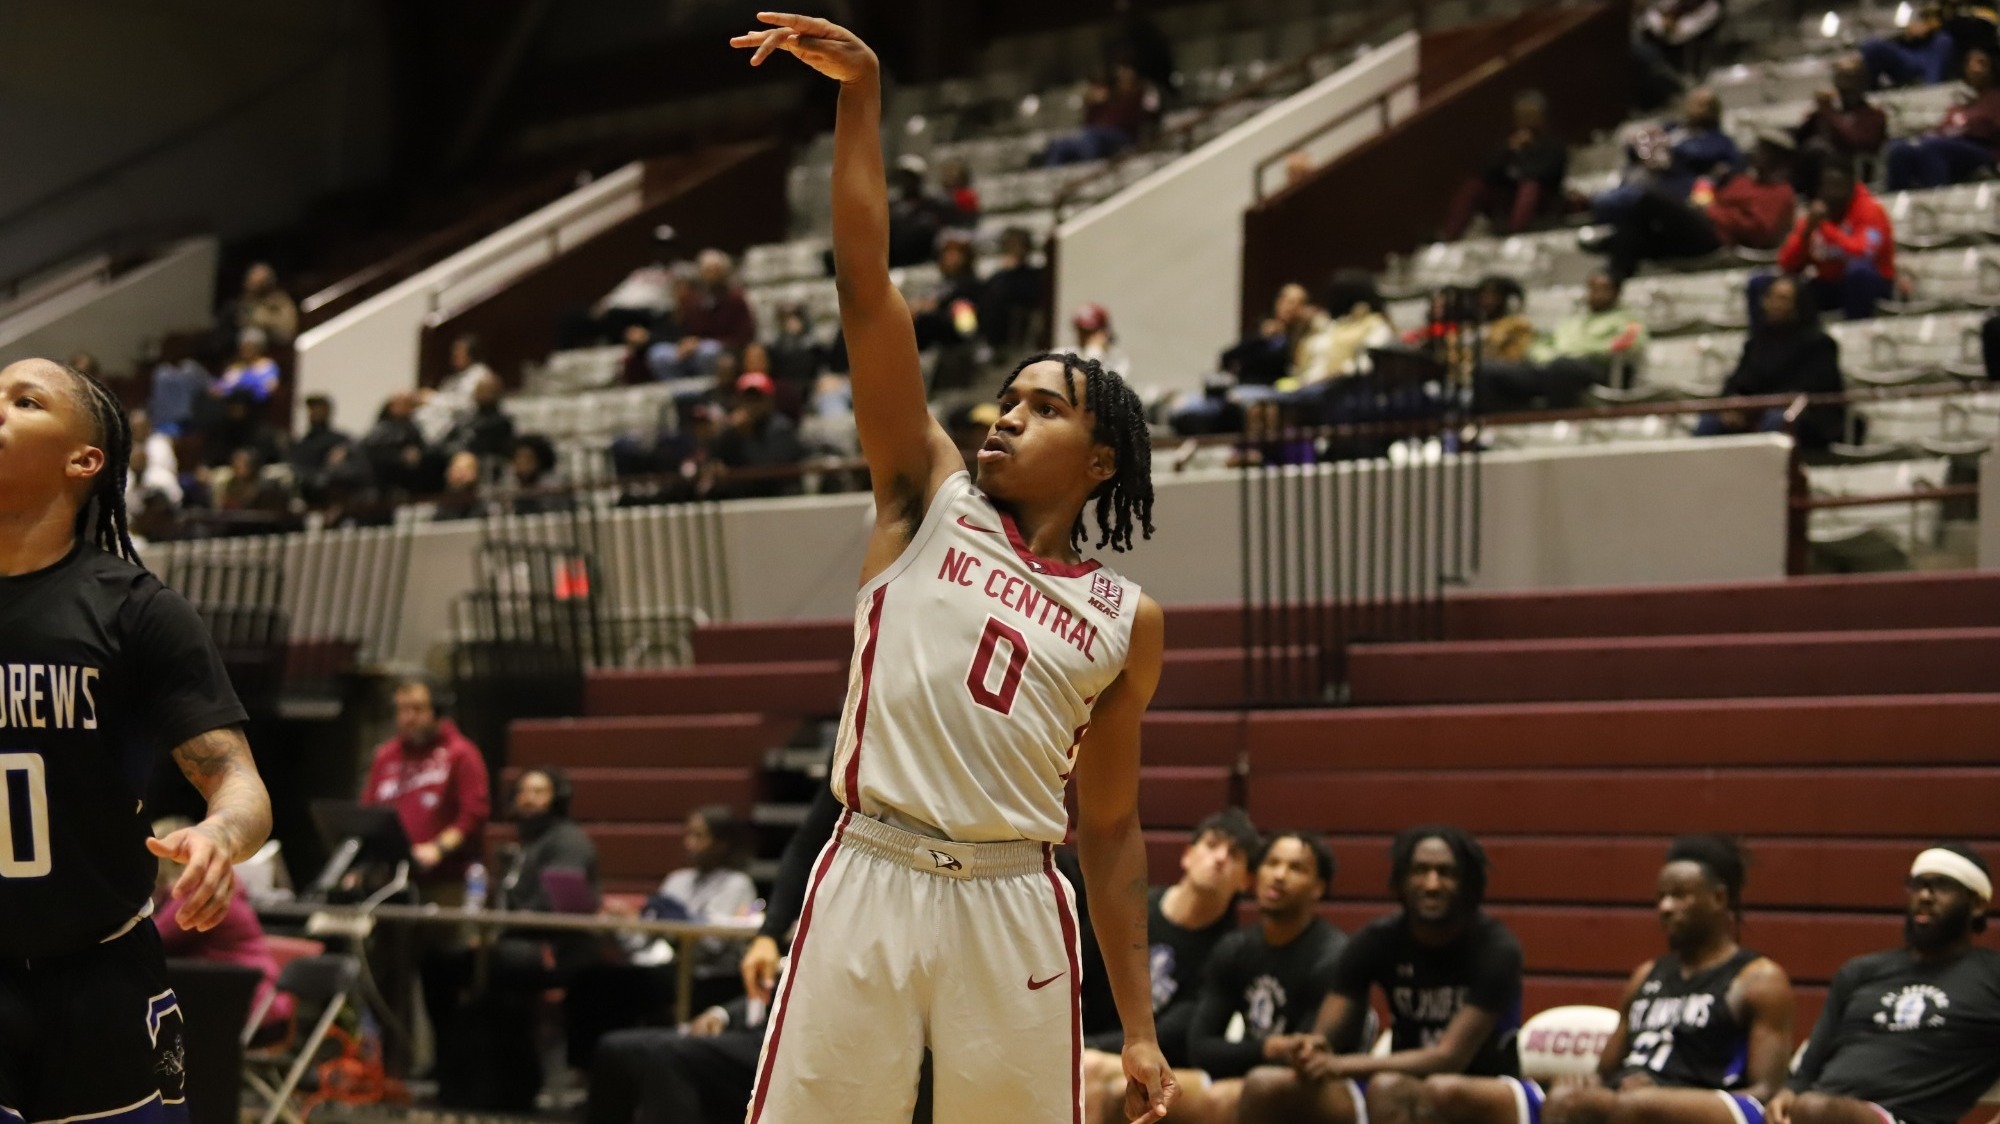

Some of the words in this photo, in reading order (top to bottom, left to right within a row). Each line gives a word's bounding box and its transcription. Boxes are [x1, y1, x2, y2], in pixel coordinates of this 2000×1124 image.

[938, 547, 982, 587] NC
[984, 569, 1098, 663] CENTRAL
[1088, 597, 1119, 619] MEAC
[965, 612, 1031, 719] 0
